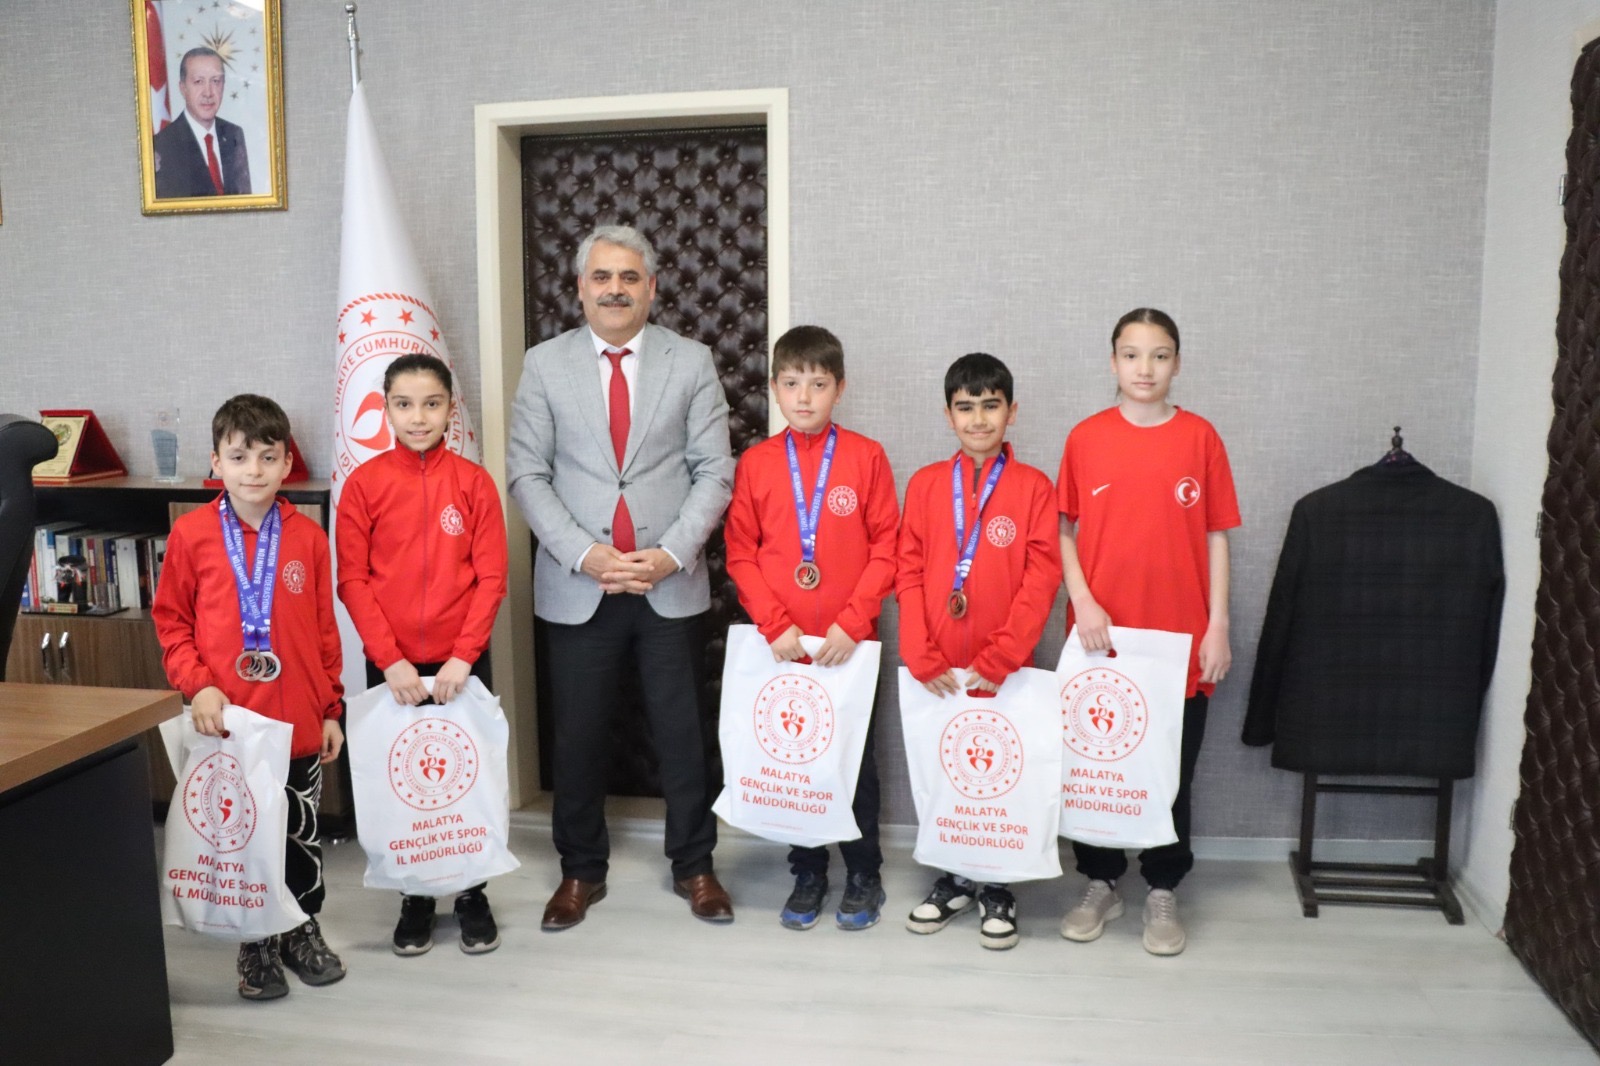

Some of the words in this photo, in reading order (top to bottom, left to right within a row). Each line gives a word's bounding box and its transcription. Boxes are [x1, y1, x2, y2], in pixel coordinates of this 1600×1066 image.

[267, 534, 279, 567] BADMINTON
[232, 555, 250, 590] BADMINTON
[253, 548, 266, 584] BADMINTON
[261, 573, 273, 613] FEDERASYONU
[761, 766, 811, 784] MALATYA
[1070, 768, 1124, 783] MALATYA
[740, 777, 783, 794] GENÇLİK
[787, 786, 800, 796] VE
[803, 789, 833, 801] SPOR
[1063, 783, 1097, 796] NÇLİK
[1099, 787, 1113, 797] VE
[1117, 789, 1148, 800] SPOR
[742, 793, 751, 803] İL
[753, 797, 827, 814] MÜDÜRLÜĞÜ
[955, 805, 1007, 817] MALATYA
[1065, 797, 1142, 816] MÜDÜRLÜĞÜ
[412, 813, 463, 832] MALATYA
[936, 817, 980, 832] GENÇLİK
[982, 822, 997, 832] VE
[1000, 824, 1029, 835] SPOR
[389, 834, 438, 852] GENÇLİK
[440, 830, 454, 841] VE
[457, 826, 487, 838] SPOR
[939, 833, 948, 843] İL
[951, 835, 1025, 850] MÜDÜRLÜĞÜ
[396, 853, 407, 865] İL
[410, 841, 483, 864] MÜDÜRLÜĞÜ
[219, 878, 235, 889] VE
[173, 885, 184, 897] İL
[188, 889, 264, 908] MÜDÜRLÜĞÜ
